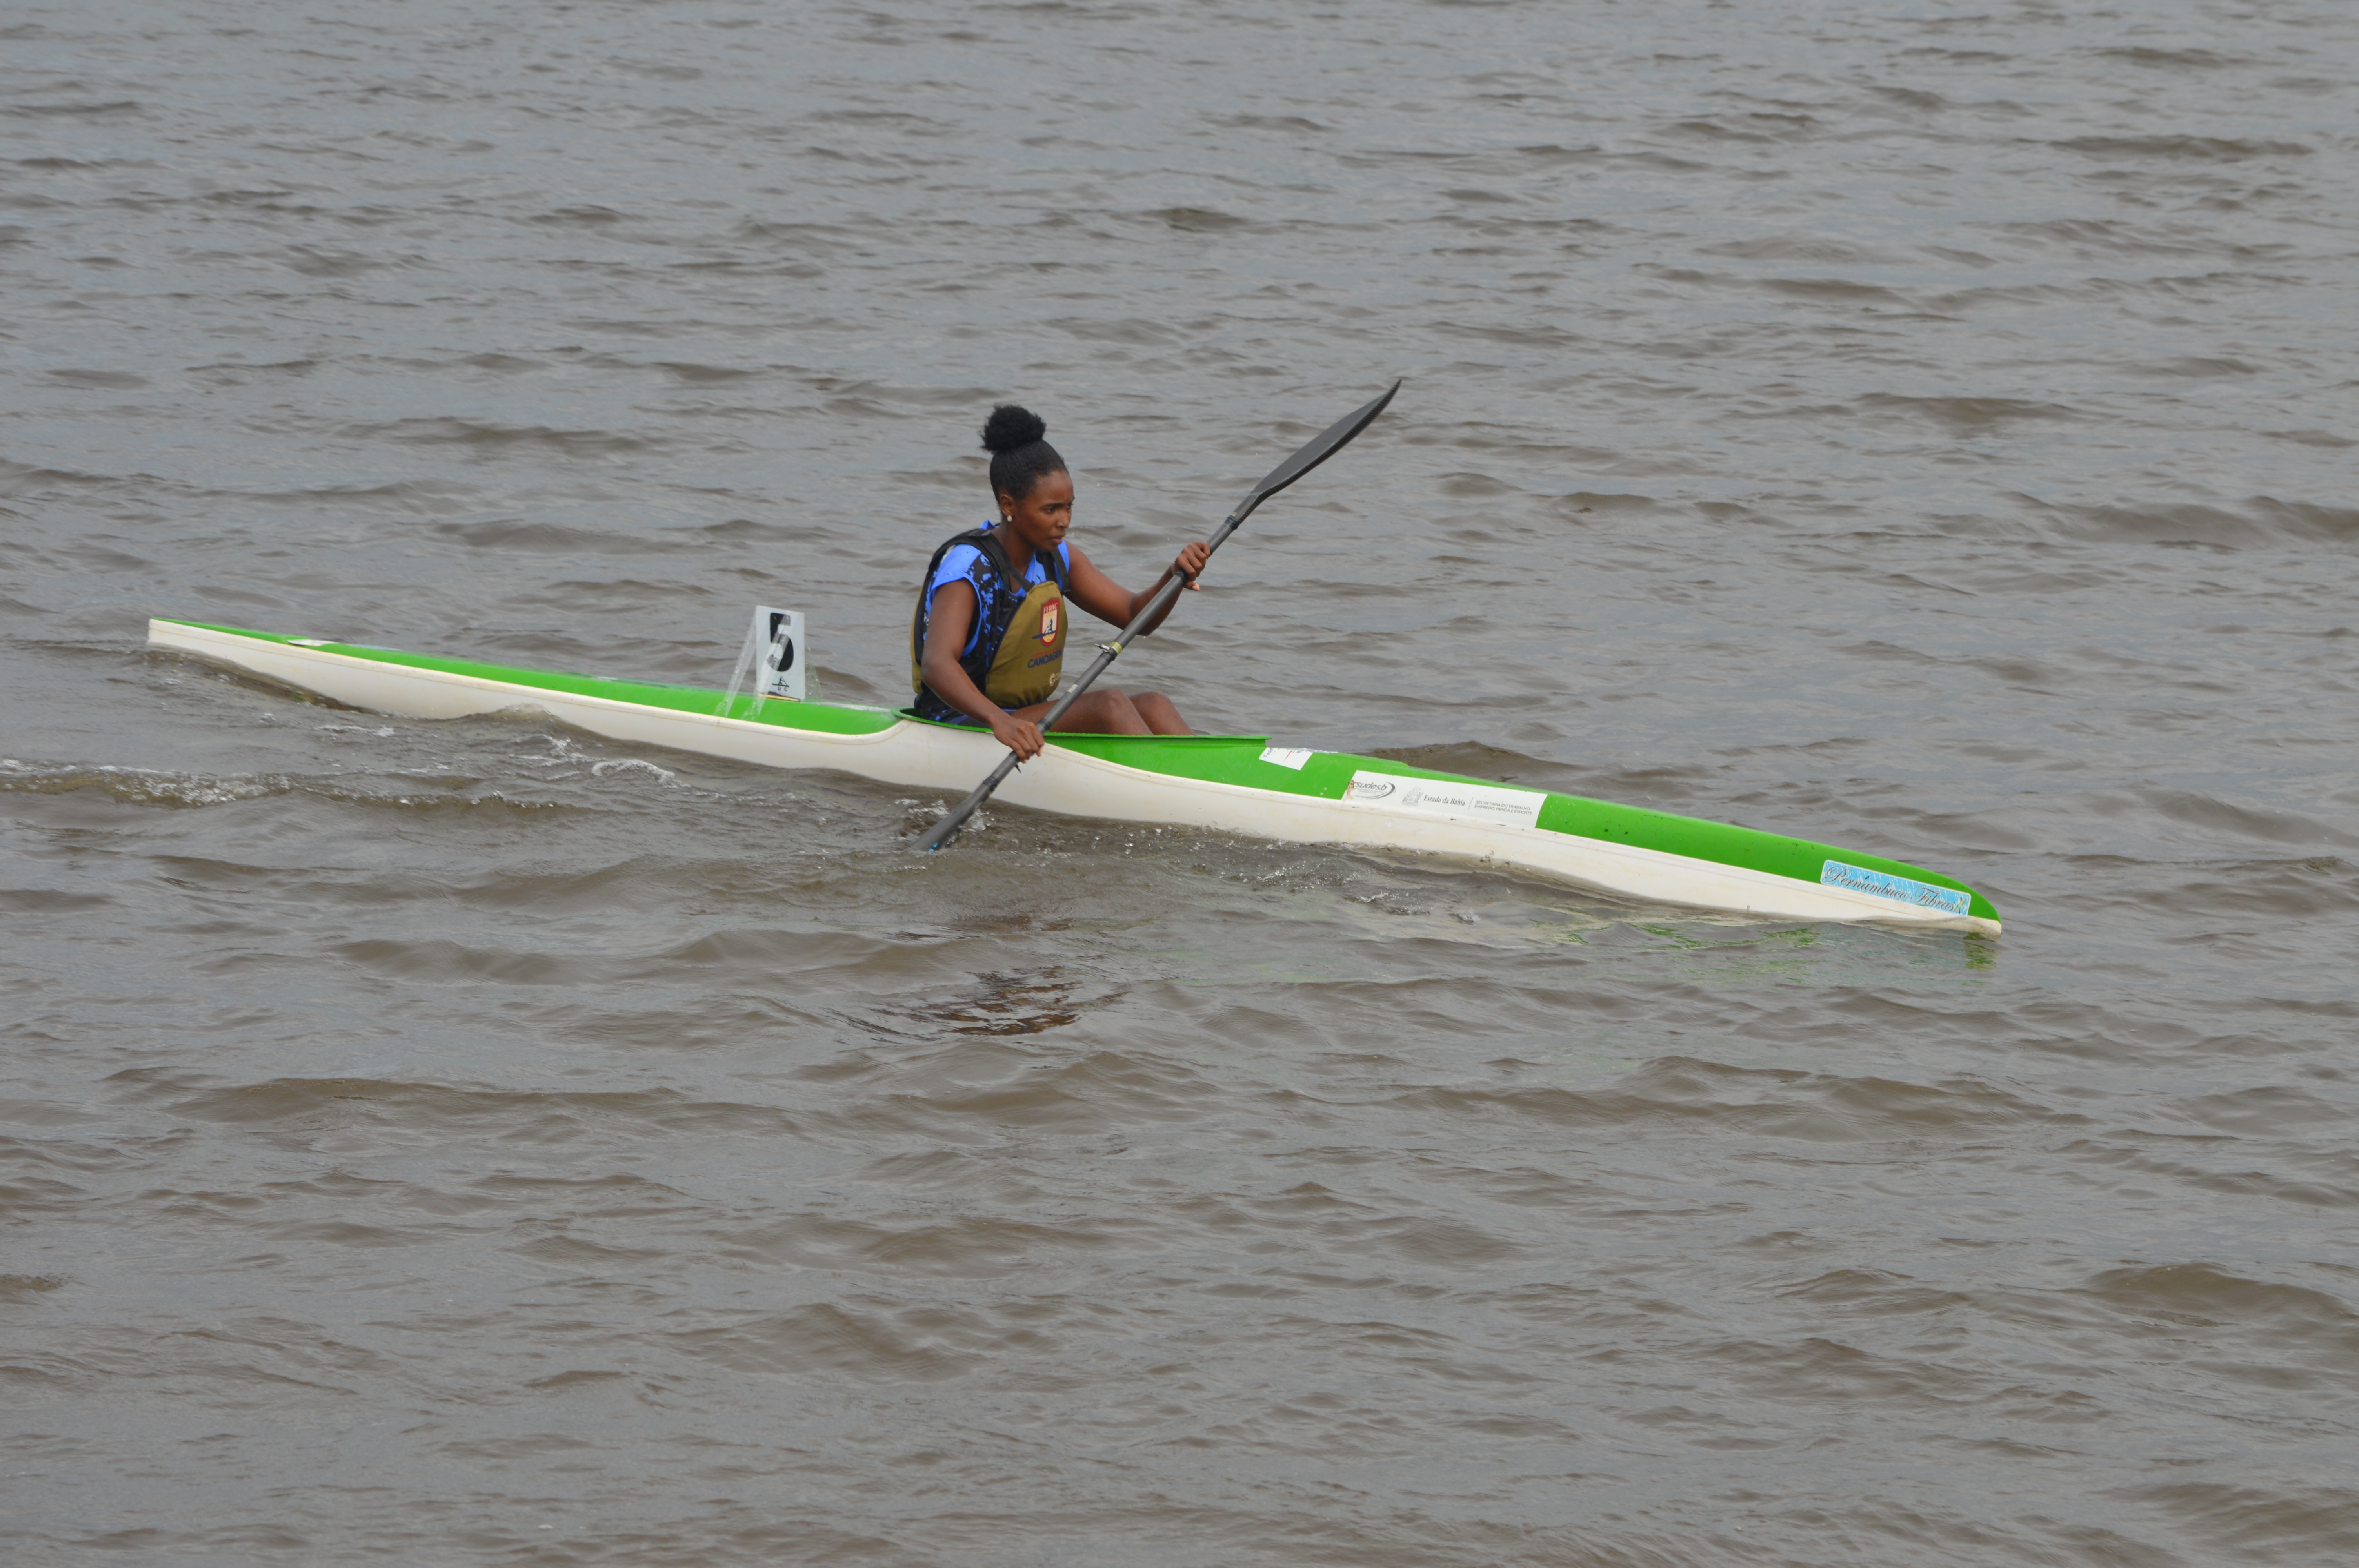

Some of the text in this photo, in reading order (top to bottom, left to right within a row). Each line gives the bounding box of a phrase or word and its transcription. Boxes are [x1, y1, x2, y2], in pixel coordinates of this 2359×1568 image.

[767, 612, 794, 672] 5
[1355, 782, 1387, 791] sudesb
[1825, 866, 1956, 911] Pernambuco Fibras
